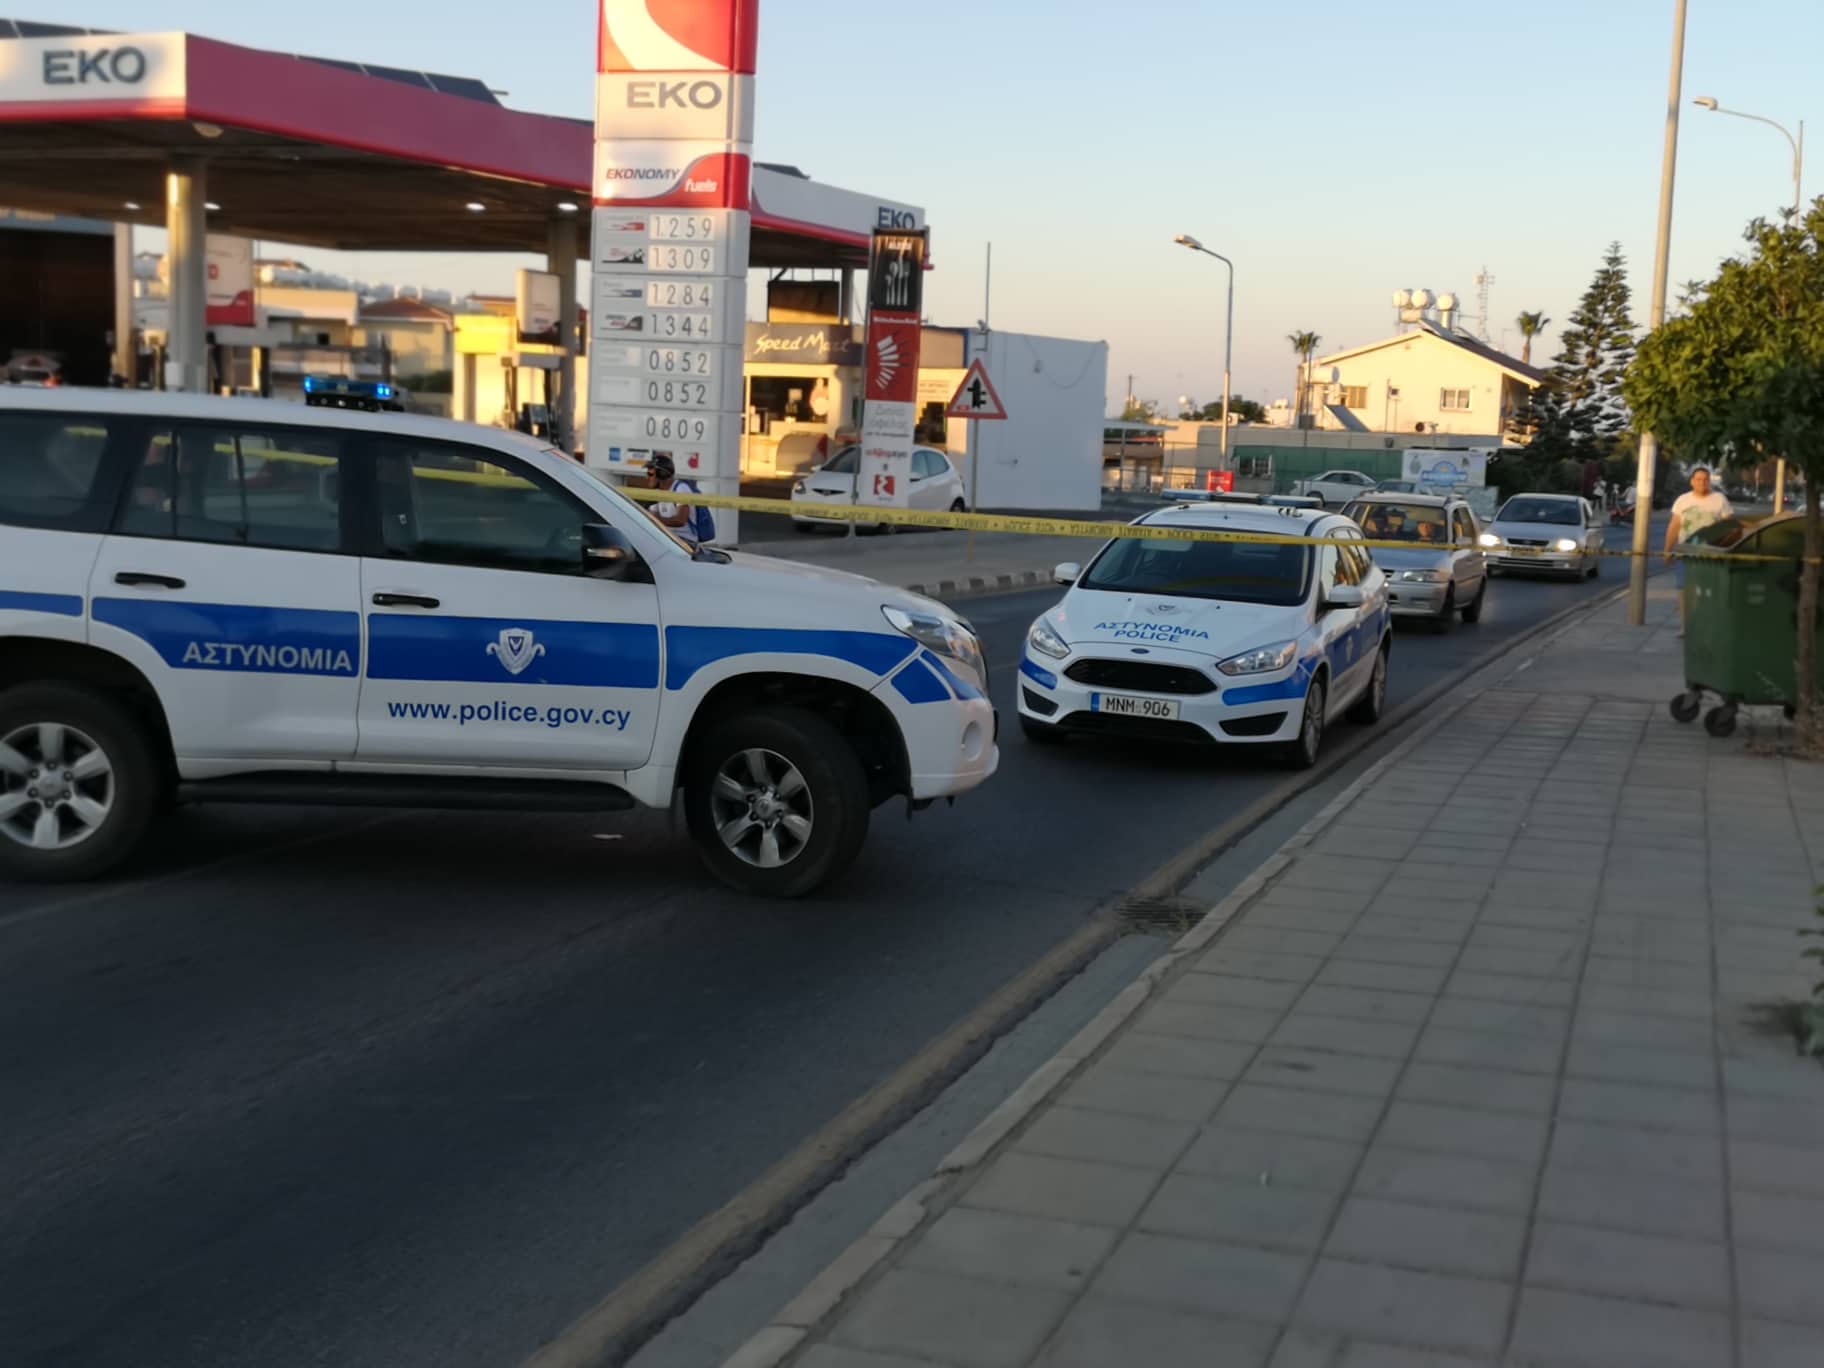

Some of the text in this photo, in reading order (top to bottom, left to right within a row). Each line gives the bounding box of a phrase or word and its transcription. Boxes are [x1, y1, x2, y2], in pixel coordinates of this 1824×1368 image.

[43, 46, 146, 84] EKO
[626, 80, 723, 109] EKO
[606, 168, 680, 180] EKONOMY
[877, 206, 916, 229] EKO
[753, 334, 802, 354] Speed
[1094, 621, 1210, 640] ΑΣΤΥΝΟΜΙΑ
[1114, 630, 1182, 643] POLICE
[182, 641, 352, 671] ΑΣΤΥΝΟΜΙΑ
[387, 701, 631, 731] www.police.gov.cy
[1105, 697, 1170, 717] MNM 906
